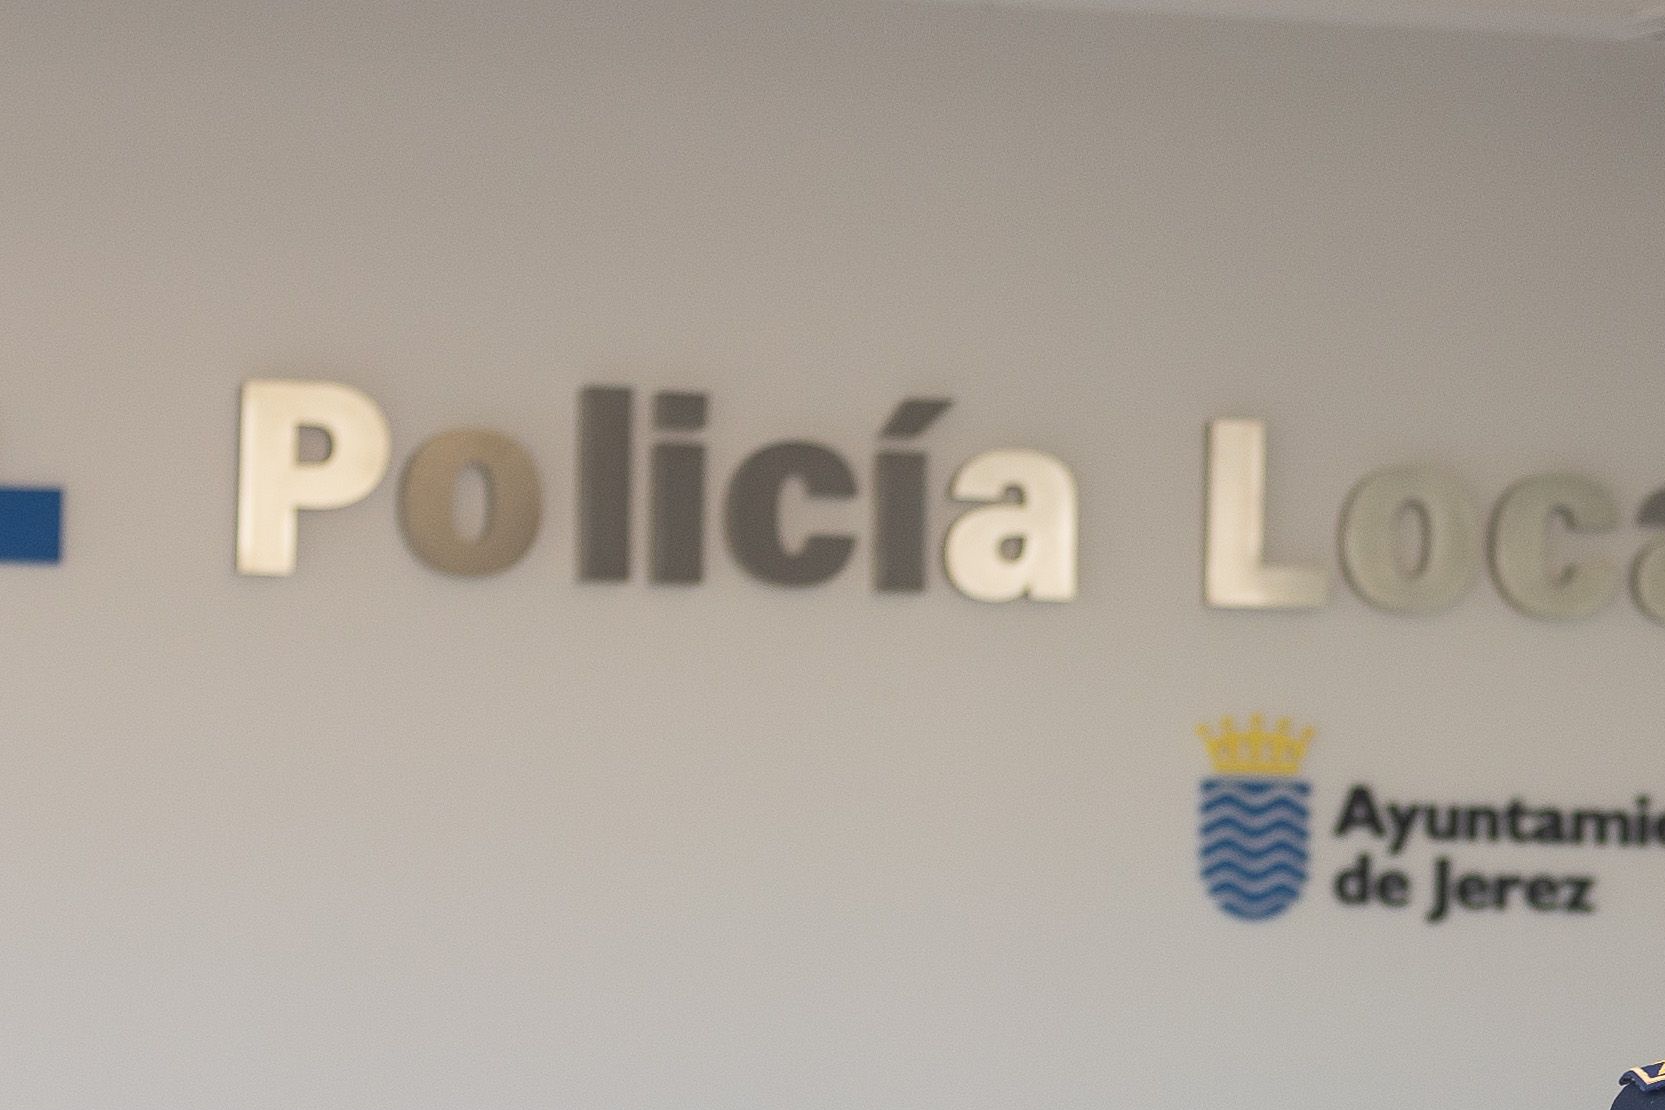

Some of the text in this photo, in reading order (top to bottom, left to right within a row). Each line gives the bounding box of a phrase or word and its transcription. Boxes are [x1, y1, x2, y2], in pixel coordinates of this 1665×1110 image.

[235, 378, 1078, 603] Policía
[1333, 853, 1596, 921] de Jerez
